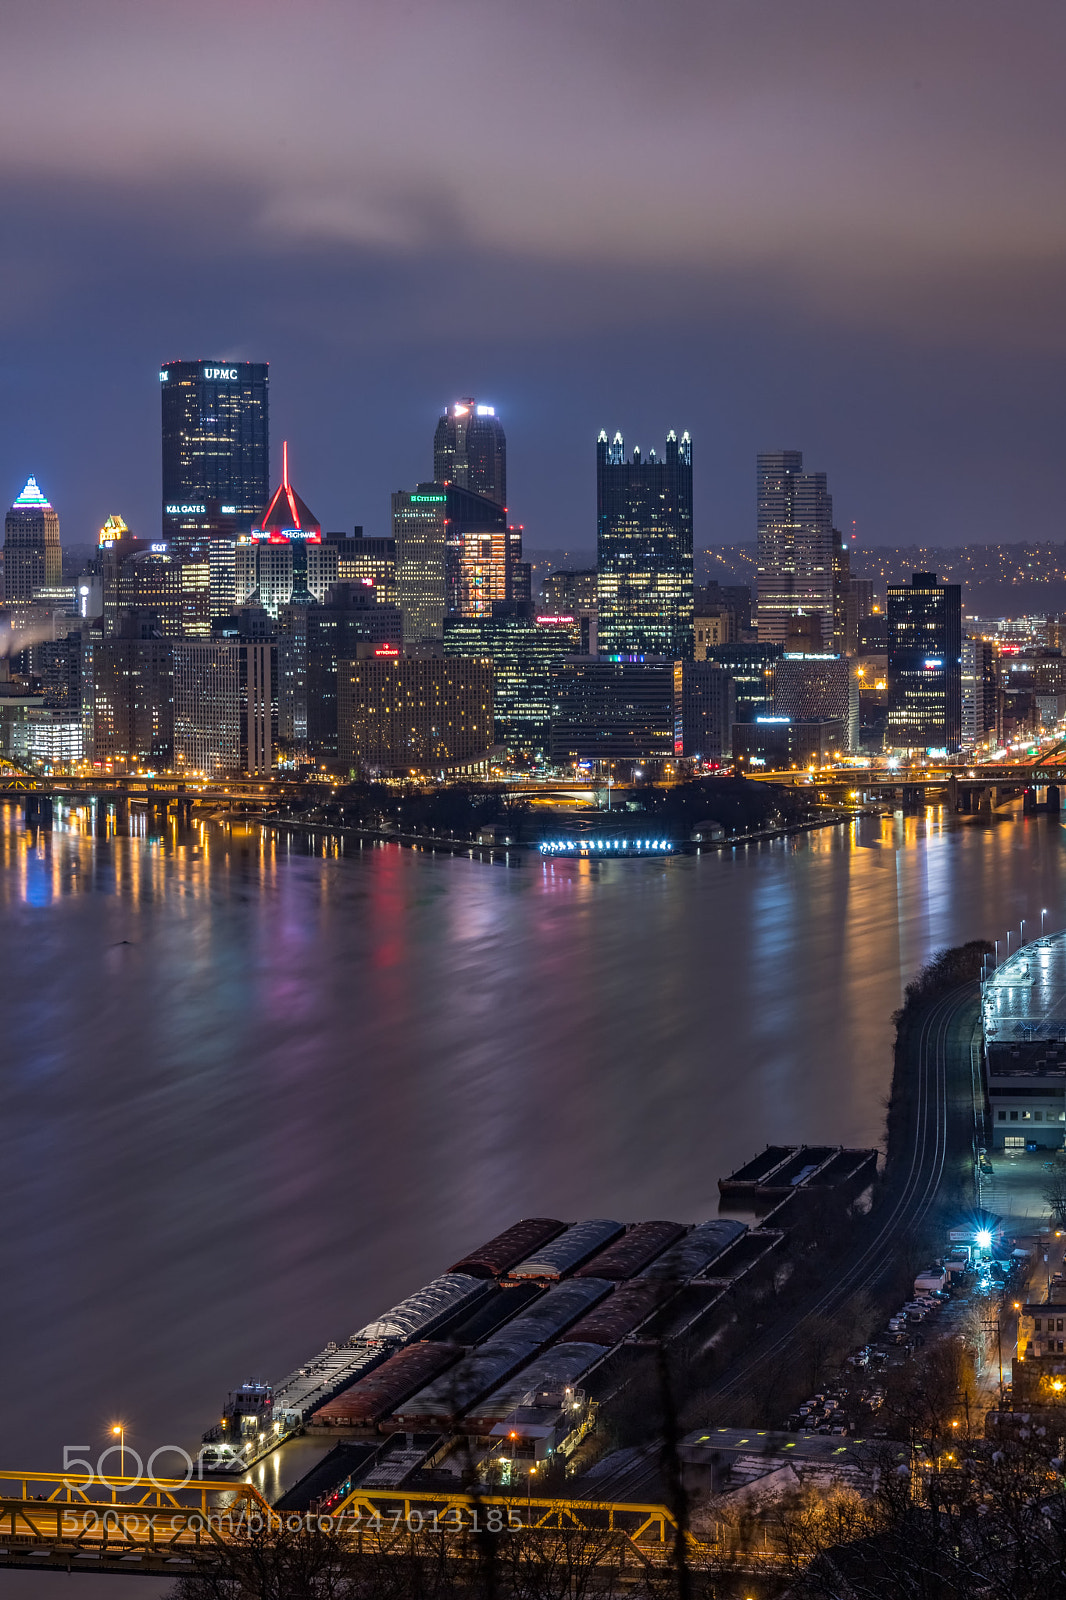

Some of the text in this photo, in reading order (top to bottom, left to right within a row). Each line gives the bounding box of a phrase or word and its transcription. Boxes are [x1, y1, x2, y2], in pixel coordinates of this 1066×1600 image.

[204, 368, 243, 380] UPMC
[166, 505, 206, 513] K&L GATES
[151, 543, 168, 552] EQT
